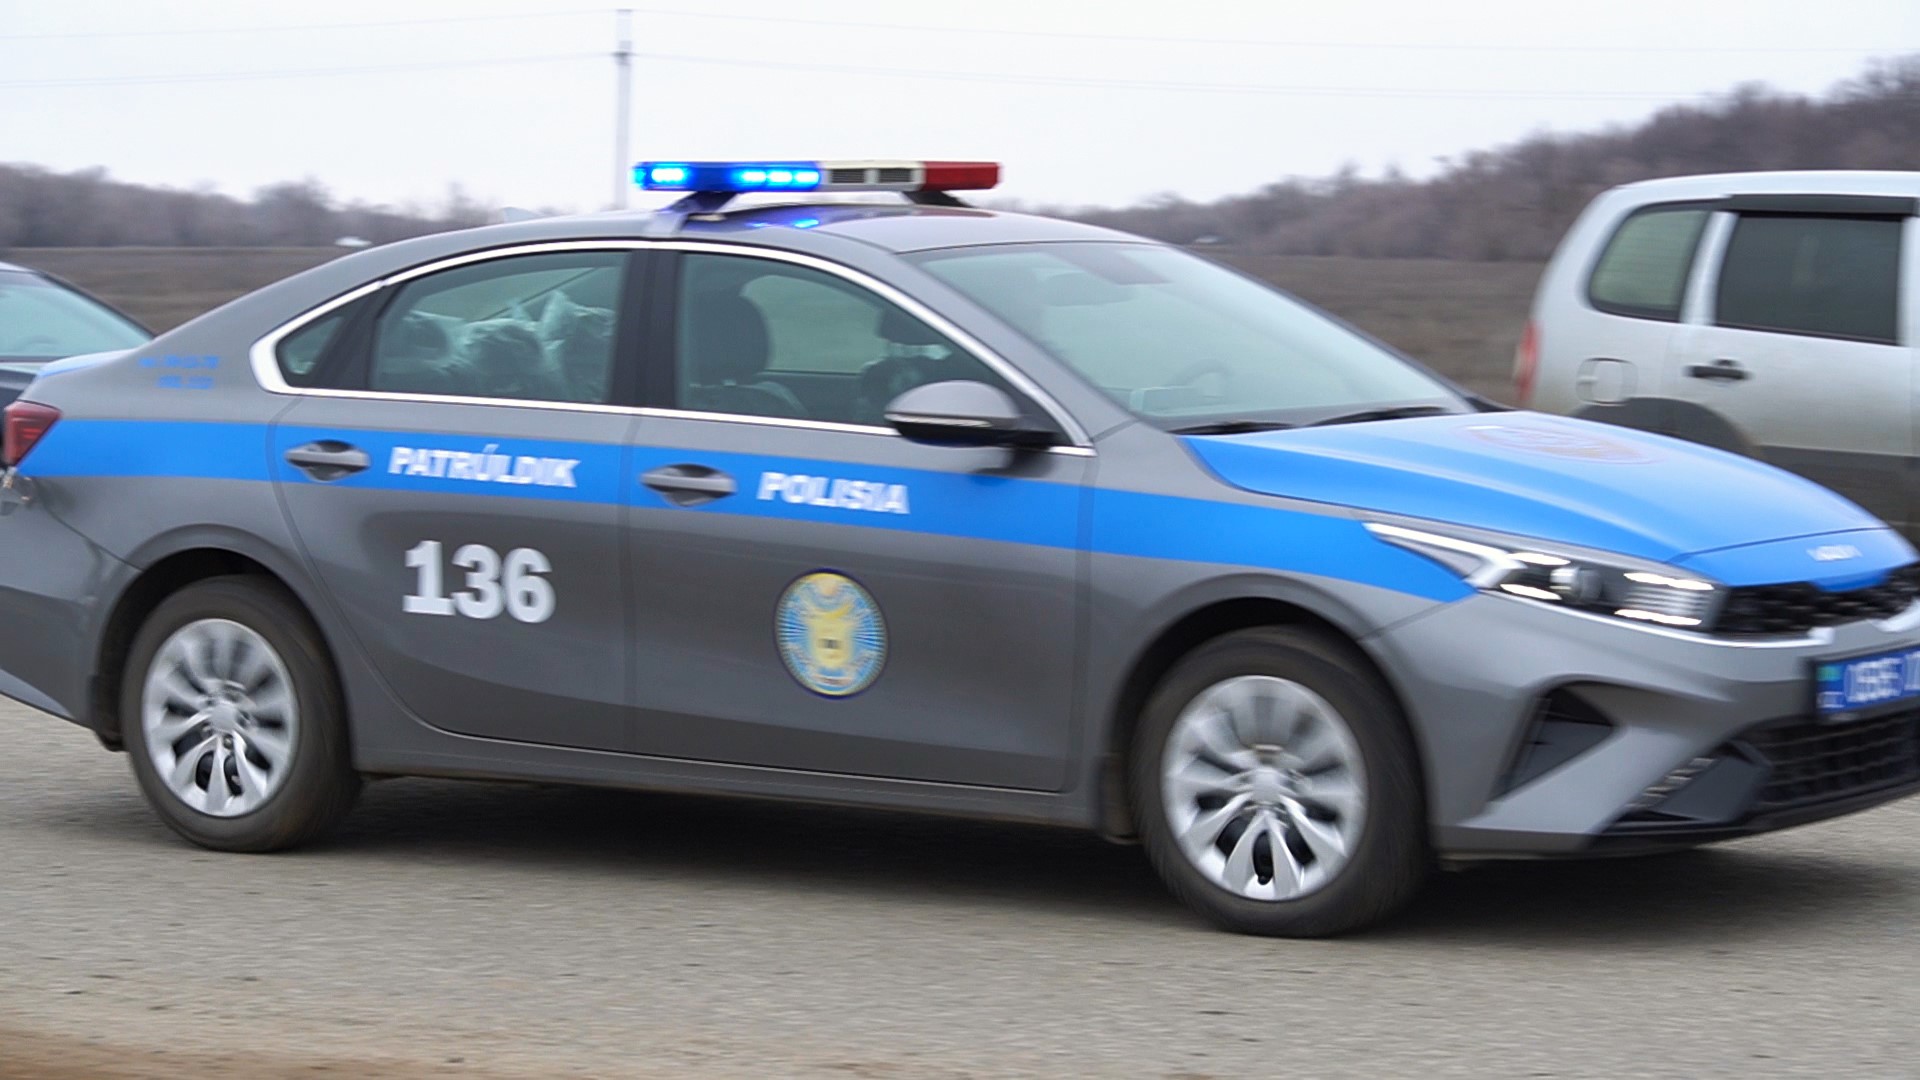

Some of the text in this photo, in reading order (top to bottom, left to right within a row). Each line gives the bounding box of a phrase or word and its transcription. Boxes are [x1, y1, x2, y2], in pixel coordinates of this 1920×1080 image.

[388, 444, 910, 514] PATRÚLDIK POLISIA
[402, 540, 556, 623] 136
